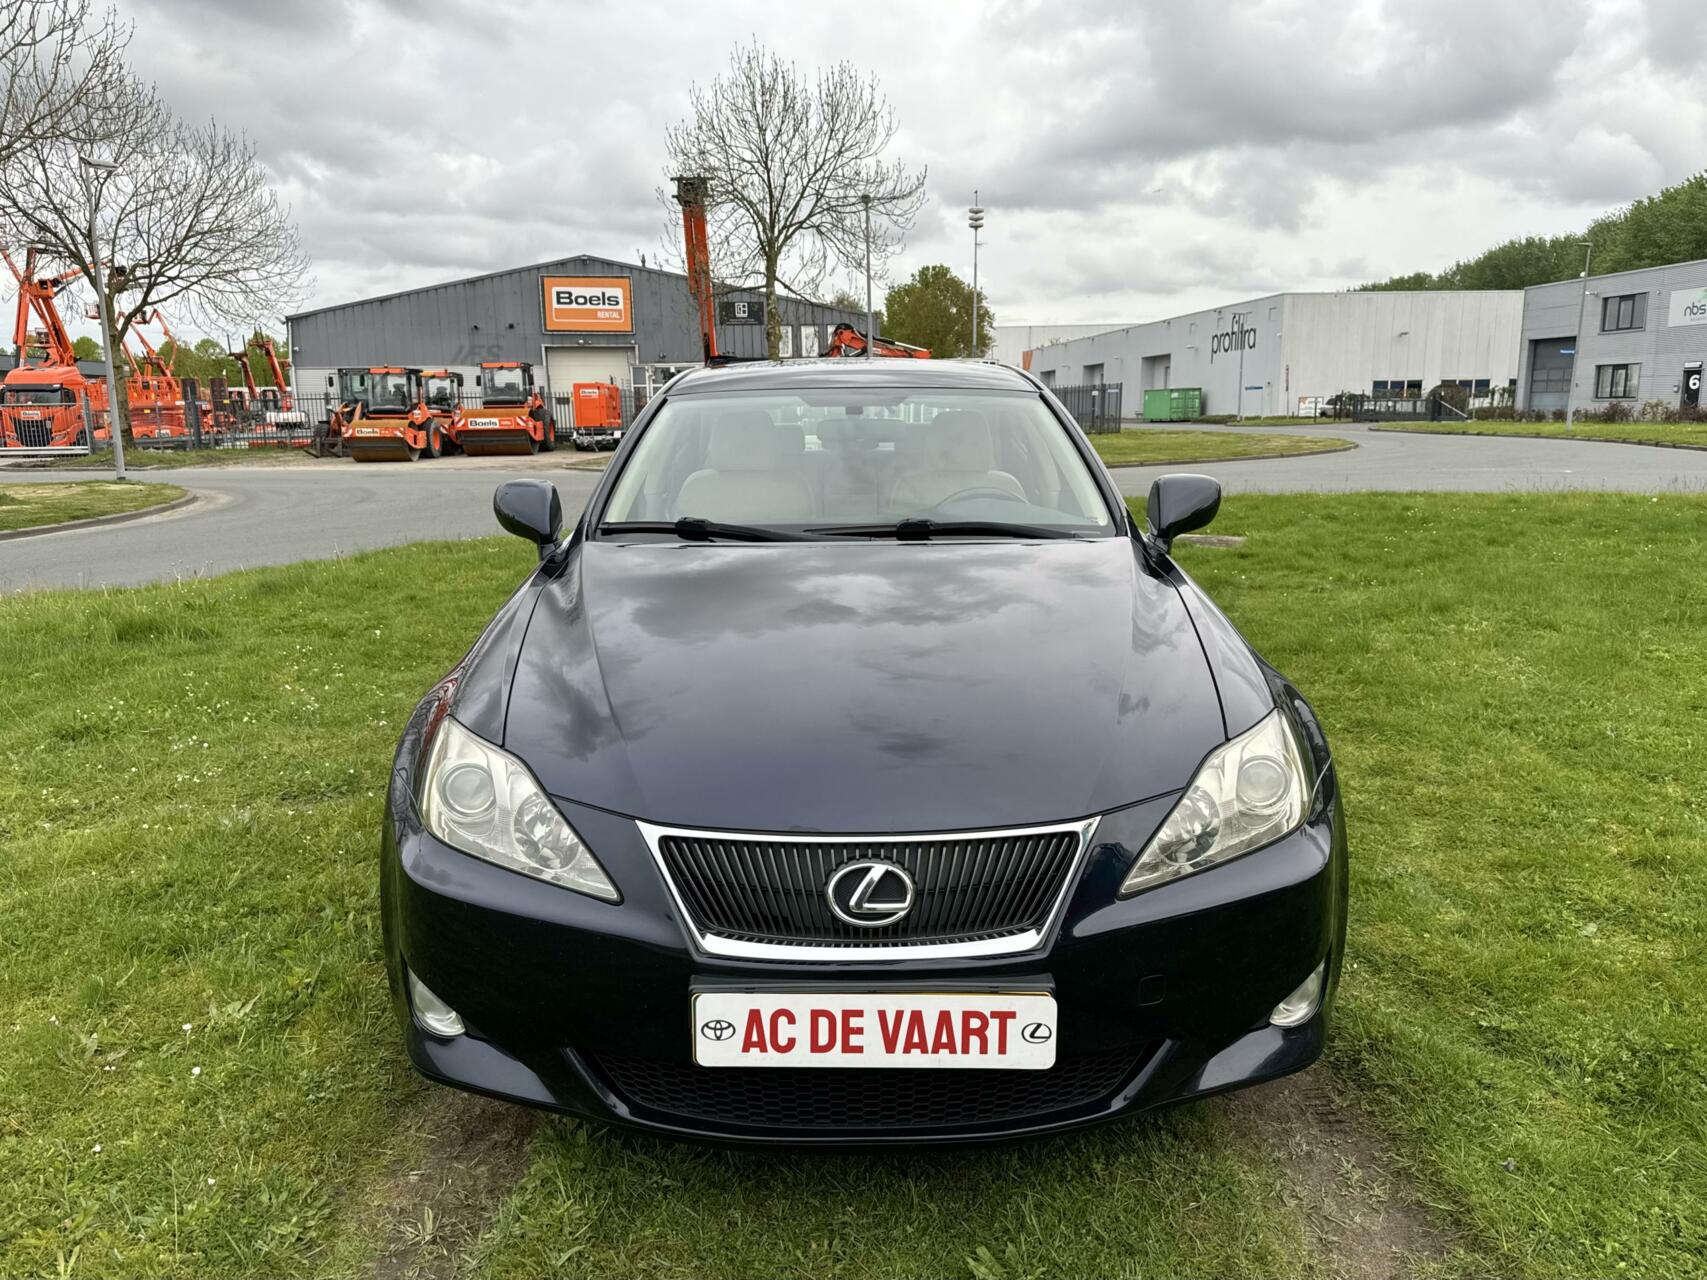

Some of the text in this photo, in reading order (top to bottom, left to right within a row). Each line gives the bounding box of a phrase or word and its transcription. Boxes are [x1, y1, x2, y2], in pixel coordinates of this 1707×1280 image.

[555, 290, 620, 306] Boels
[597, 311, 620, 319] RENTAL
[1684, 301, 1707, 317] nbs
[1211, 313, 1256, 364] profiltra
[1688, 374, 1700, 390] 6
[741, 1008, 1017, 1055] AC DE VAART
